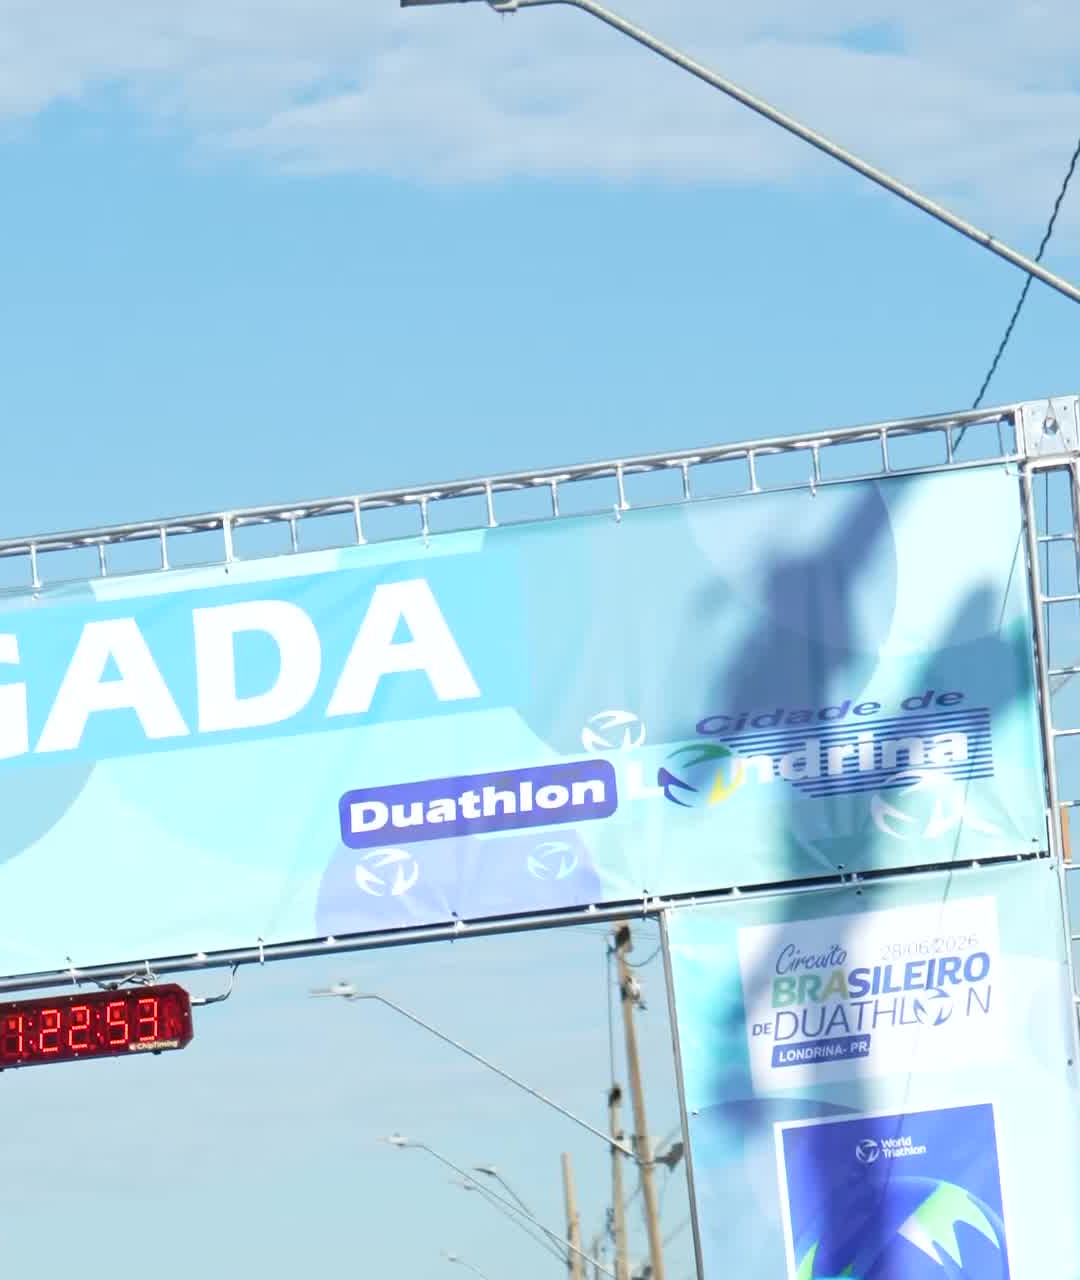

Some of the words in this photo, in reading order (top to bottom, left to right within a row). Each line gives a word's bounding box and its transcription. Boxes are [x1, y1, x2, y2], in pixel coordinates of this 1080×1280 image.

[696, 698, 882, 737] Cidade
[900, 689, 966, 716] de
[348, 778, 606, 832] Duathlon
[775, 944, 848, 975] Circuito
[772, 952, 991, 1008] BRASILEIRO
[752, 1022, 773, 1037] DE
[881, 1136, 912, 1148] World
[882, 1145, 927, 1158] Triathlon
